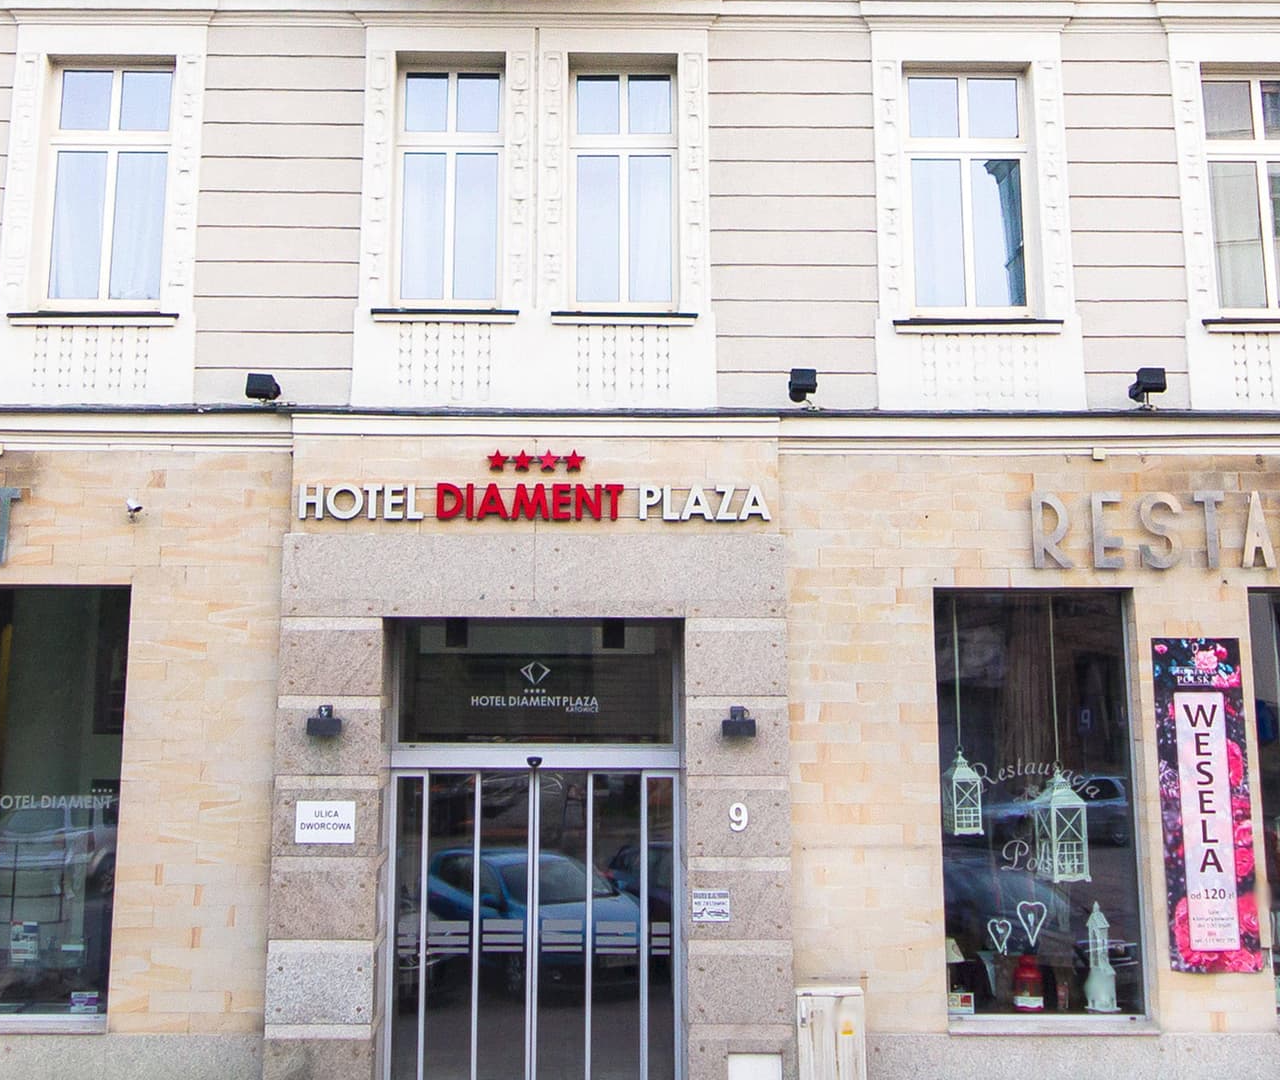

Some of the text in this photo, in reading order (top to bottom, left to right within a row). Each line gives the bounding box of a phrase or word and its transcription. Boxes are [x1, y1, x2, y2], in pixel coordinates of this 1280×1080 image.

[298, 482, 772, 522] HOTEL DIAMENT PLAZA
[471, 696, 598, 707] HOTEL DIAMENT PLAZA
[1183, 704, 1224, 873] WESELA
[40, 795, 113, 809] DIAMENT
[314, 810, 339, 818] ULICA
[729, 802, 749, 832] 9
[300, 822, 351, 830] DWORCOWA
[1204, 888, 1226, 900] 120
